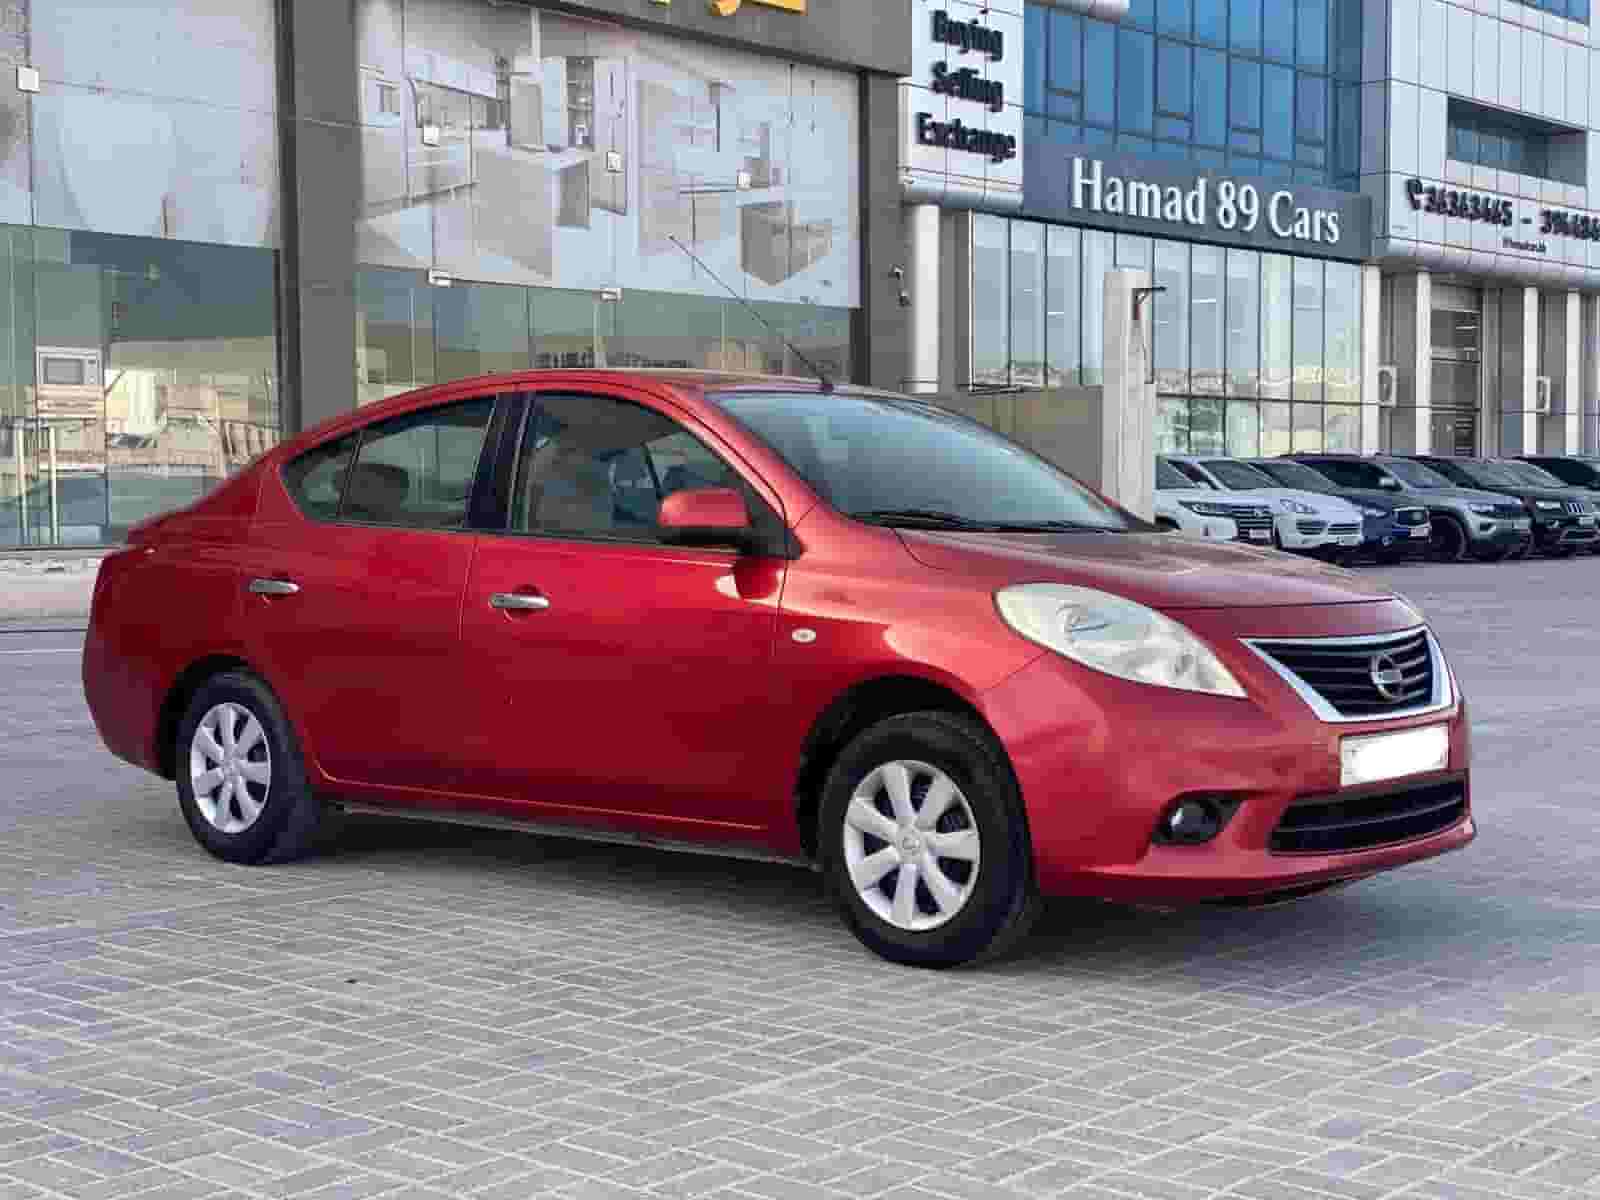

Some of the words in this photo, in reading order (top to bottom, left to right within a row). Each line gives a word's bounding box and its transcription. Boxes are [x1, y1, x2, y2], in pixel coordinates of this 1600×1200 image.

[932, 10, 1003, 61] Buying
[931, 61, 1003, 112] Selling
[916, 112, 1017, 163] Exchange
[1071, 157, 1207, 225] Hamad
[1217, 180, 1259, 232] 89
[1268, 190, 1340, 244] Cars
